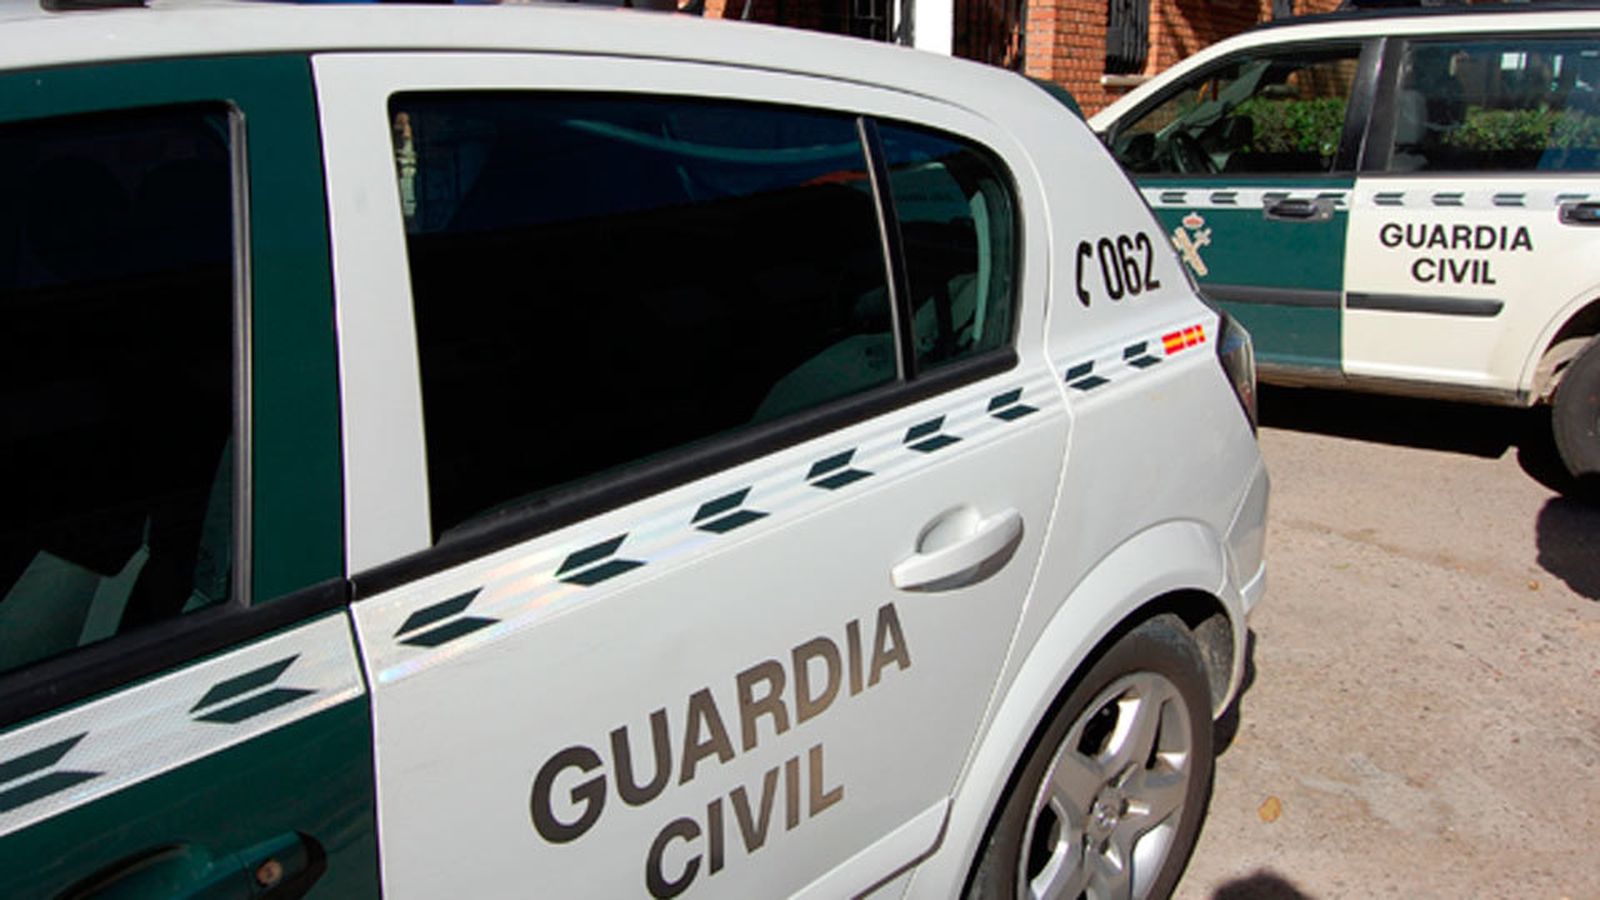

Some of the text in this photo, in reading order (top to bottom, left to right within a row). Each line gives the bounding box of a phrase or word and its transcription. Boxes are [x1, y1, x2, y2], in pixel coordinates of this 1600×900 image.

[1098, 231, 1160, 301] 062
[1379, 223, 1534, 251] GUARDIA
[1411, 258, 1497, 285] CIVIL
[530, 602, 912, 845] GUARDIA
[645, 743, 845, 900] CIVIL
